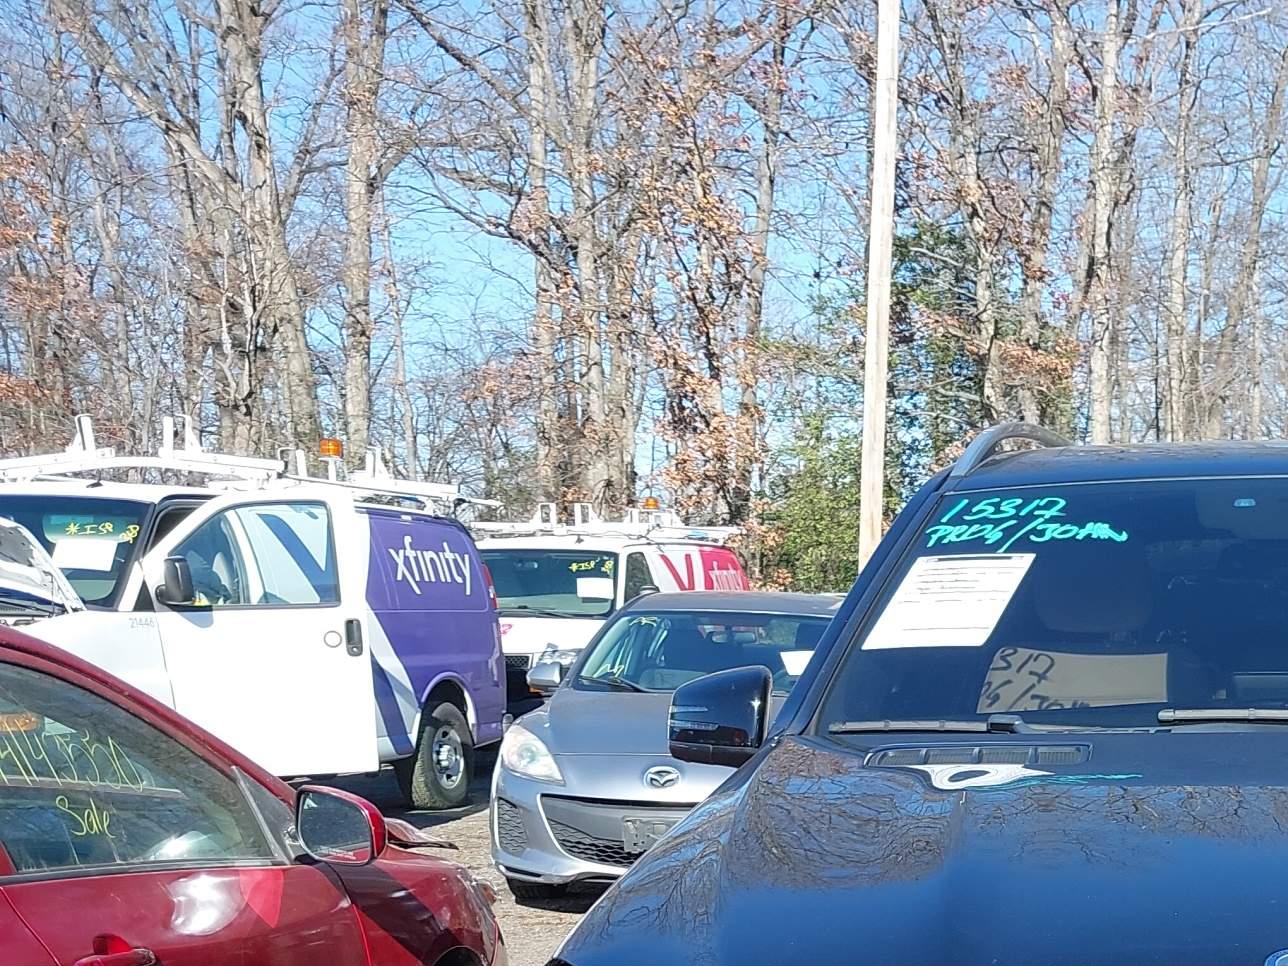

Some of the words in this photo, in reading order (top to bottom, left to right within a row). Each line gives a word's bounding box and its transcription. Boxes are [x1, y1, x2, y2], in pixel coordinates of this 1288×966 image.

[940, 498, 1066, 521] 15317
[388, 535, 471, 595] xfinity
[56, 796, 117, 839] Sale
